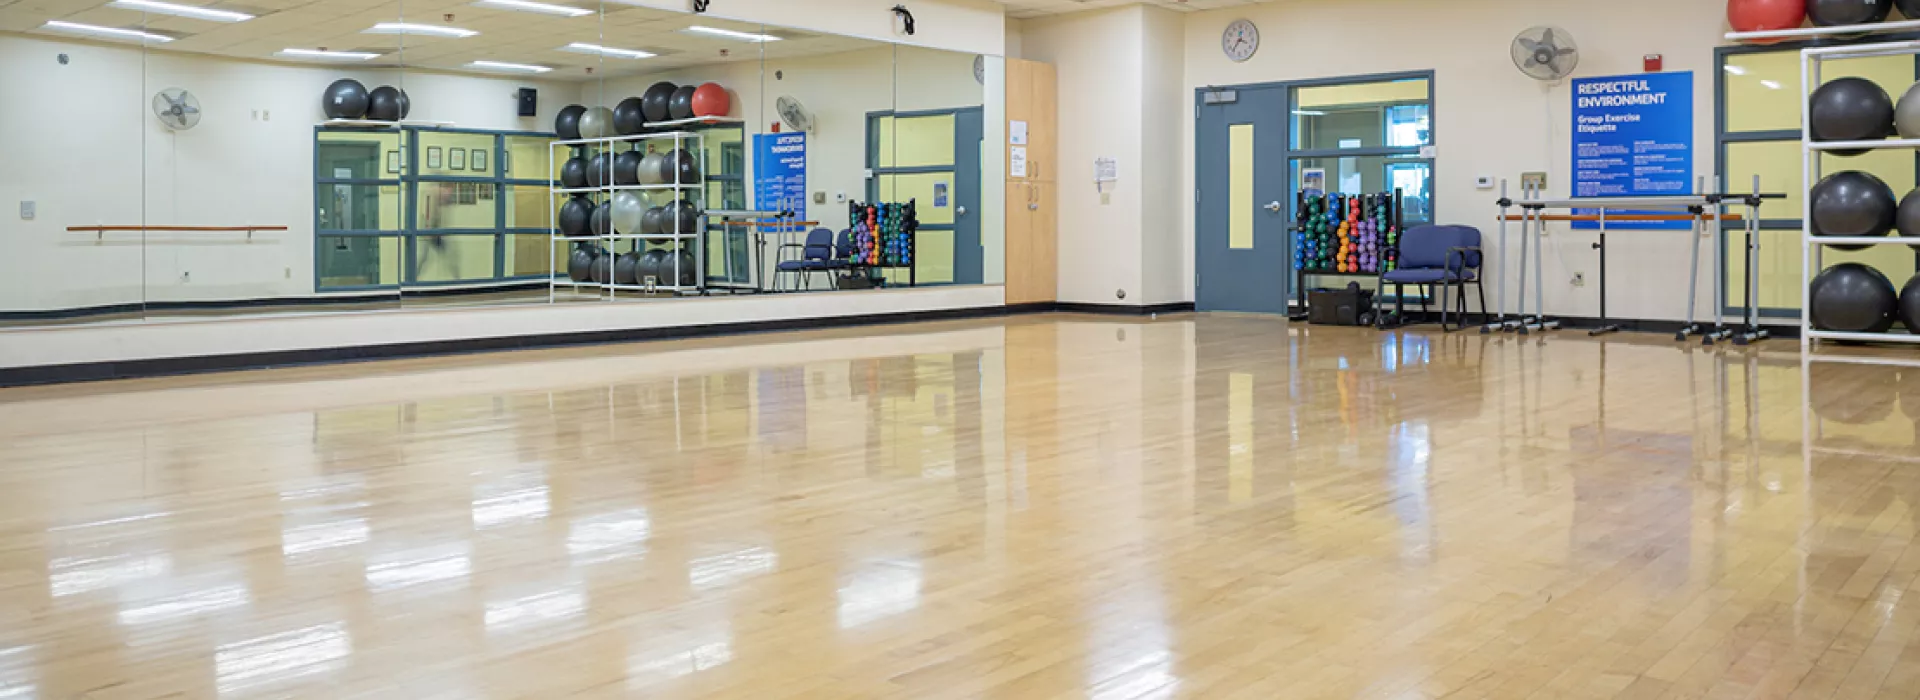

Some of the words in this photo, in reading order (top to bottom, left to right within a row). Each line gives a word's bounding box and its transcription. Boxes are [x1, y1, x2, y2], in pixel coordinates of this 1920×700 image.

[1578, 80, 1650, 95] RESPECTFUL
[1578, 92, 1666, 108] ENVIRONMENT
[1577, 115, 1604, 124] Group
[1605, 113, 1641, 122] Exercise
[1577, 124, 1617, 134] Etiquette
